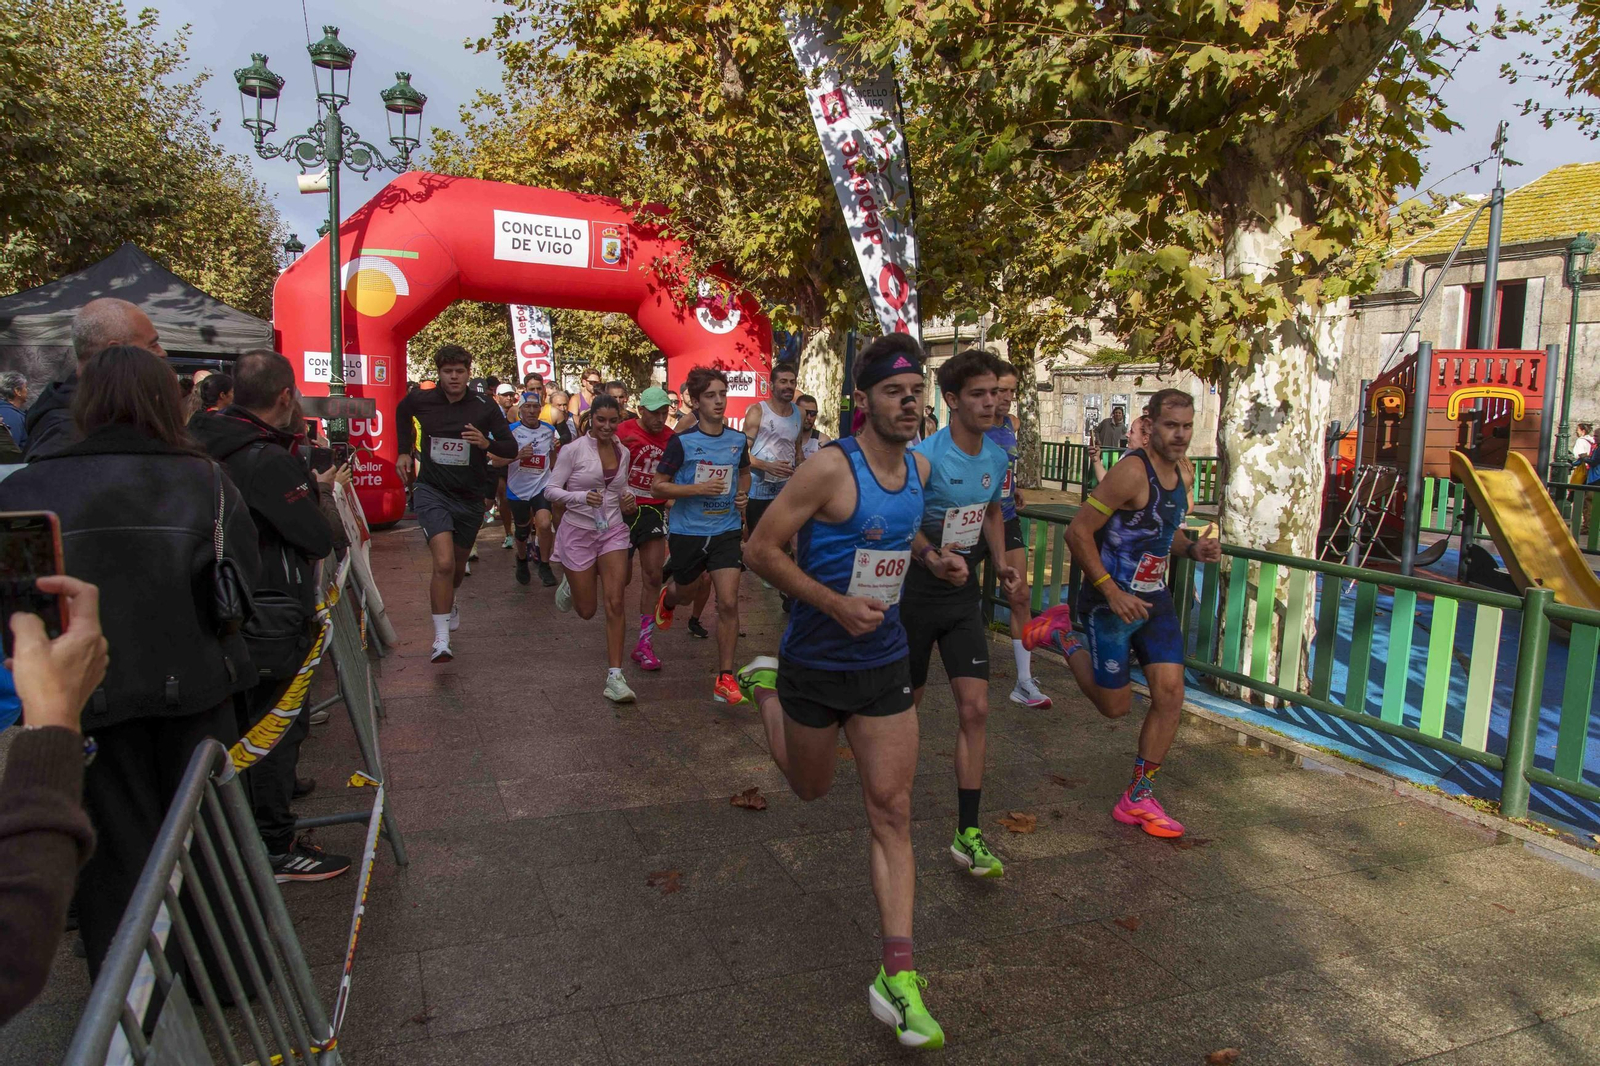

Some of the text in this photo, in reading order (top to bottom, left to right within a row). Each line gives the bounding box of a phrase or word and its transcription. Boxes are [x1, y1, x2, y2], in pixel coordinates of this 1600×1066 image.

[502, 221, 581, 240] CONCELLO
[512, 238, 572, 255] DE VIGO
[308, 357, 362, 369] CONLLO
[520, 339, 552, 380] GO
[314, 367, 356, 378] DE GO
[728, 376, 753, 384] CELLO
[730, 384, 749, 392] VIGO
[348, 409, 383, 438] GO
[442, 442, 464, 452] 675
[352, 461, 383, 471] ellor
[530, 456, 540, 465] 48
[708, 468, 728, 479] 797
[352, 474, 383, 486] orte
[639, 475, 653, 486] 13
[961, 508, 983, 527] 528
[875, 558, 906, 577] 608
